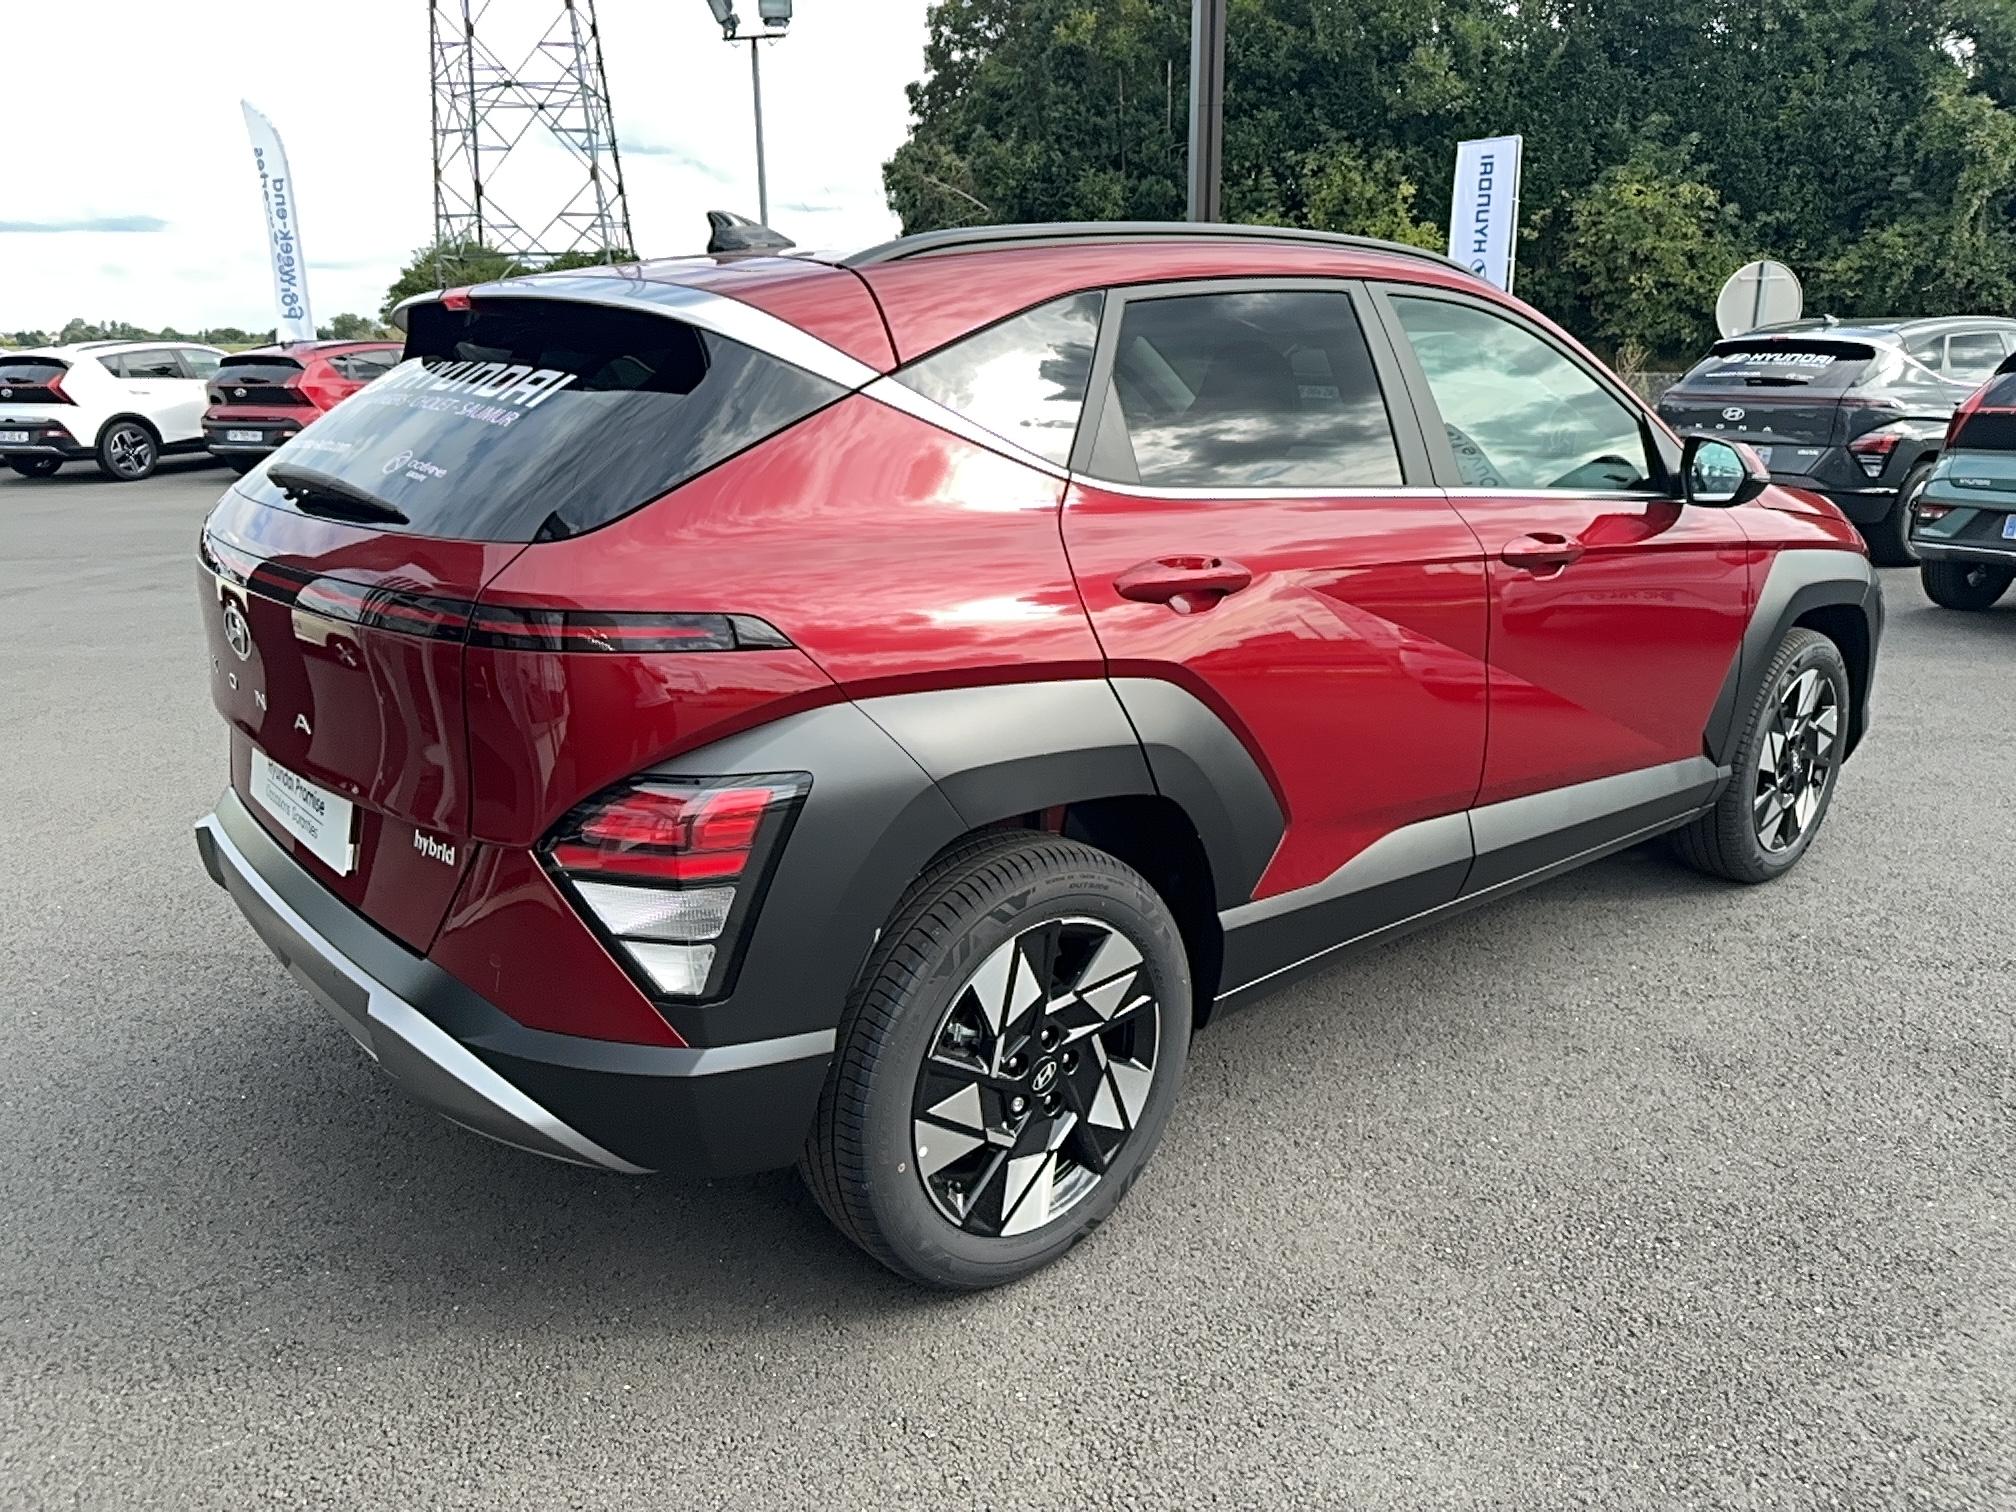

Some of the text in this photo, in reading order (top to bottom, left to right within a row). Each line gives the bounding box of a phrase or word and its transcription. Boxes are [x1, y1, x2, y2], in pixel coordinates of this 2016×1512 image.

[1749, 352, 1837, 365] HYUNDAI
[1695, 422, 1773, 433] KONA
[413, 828, 456, 866] hybrid
